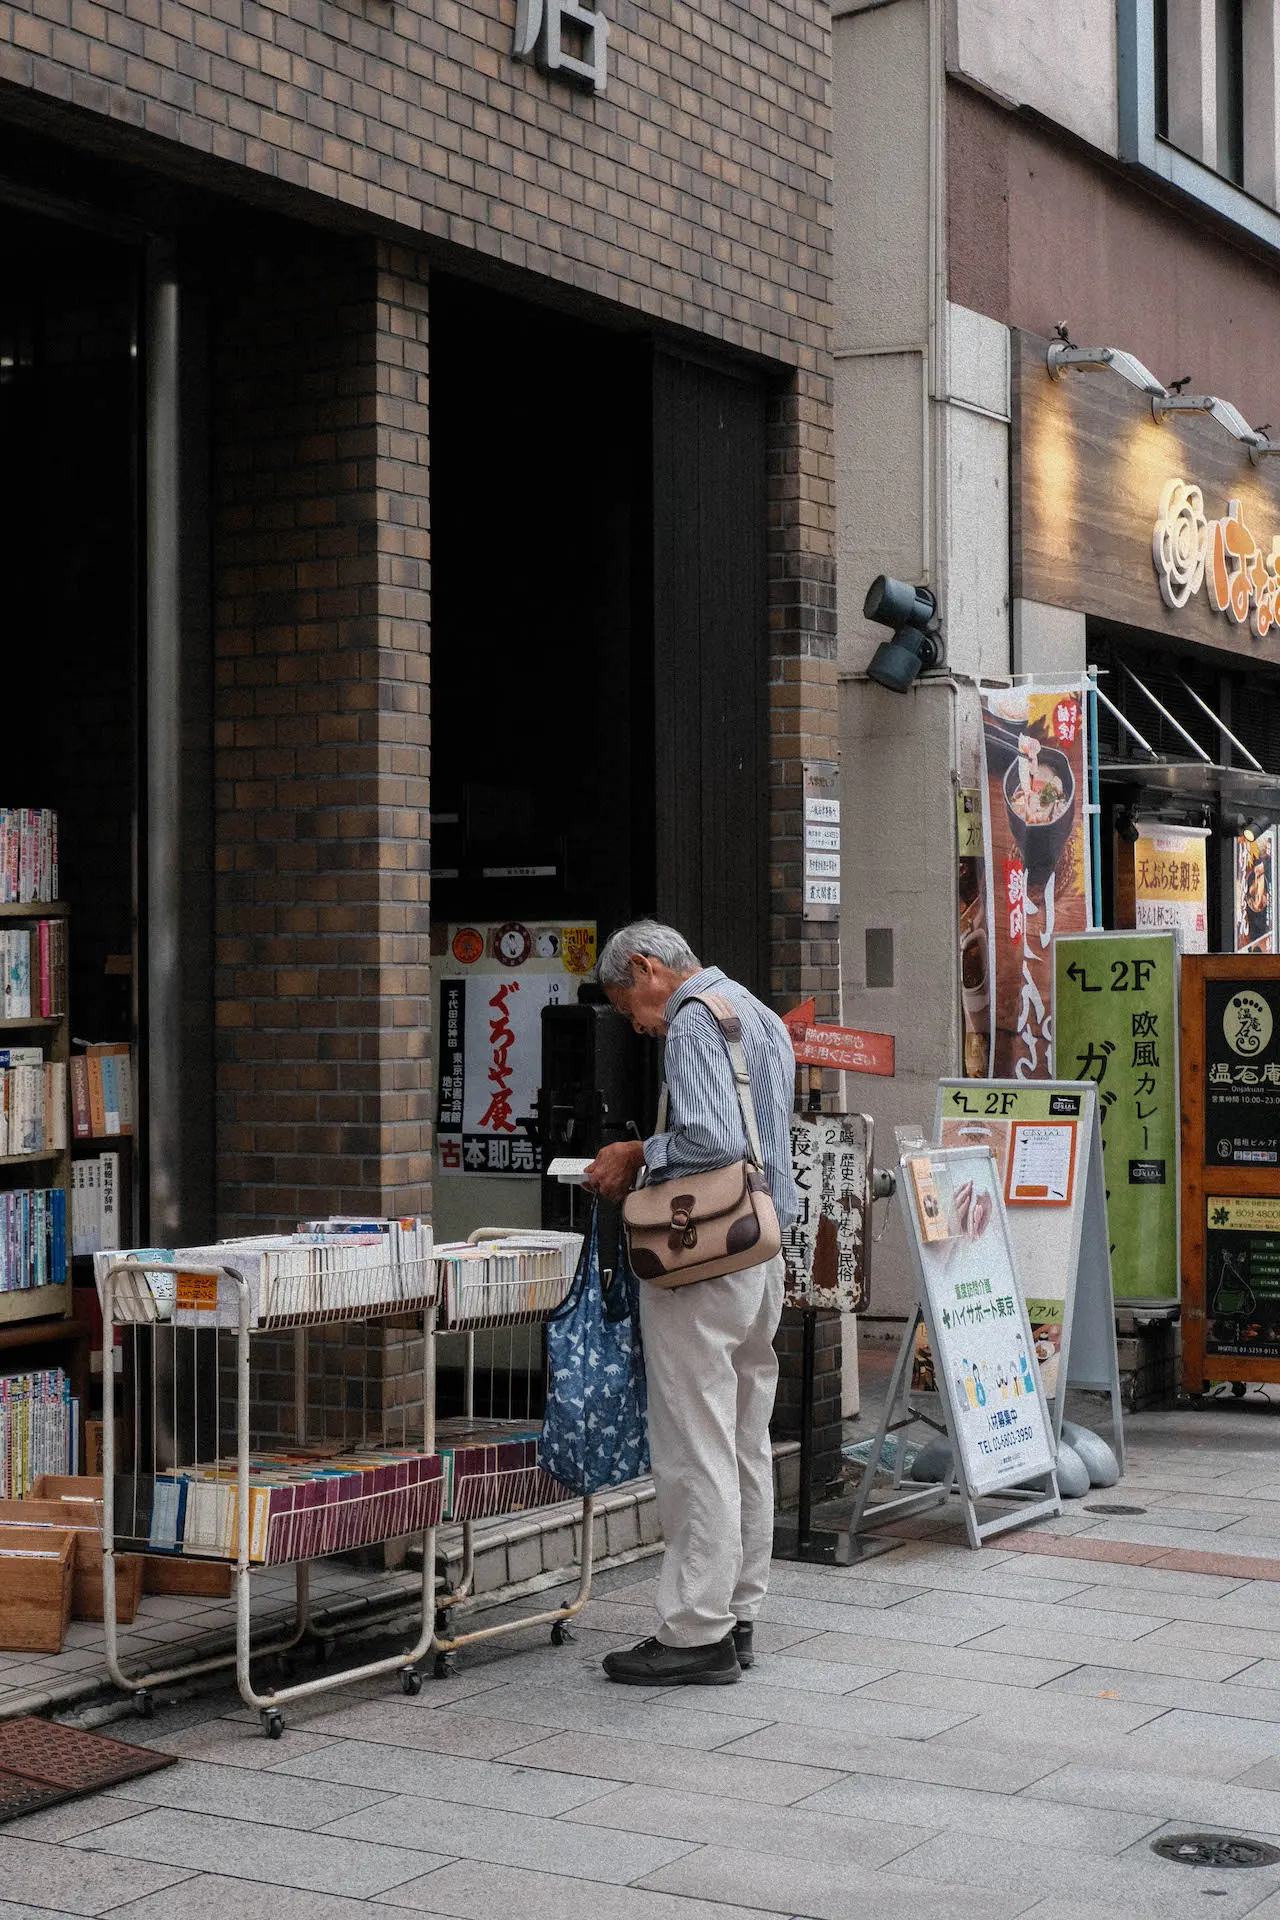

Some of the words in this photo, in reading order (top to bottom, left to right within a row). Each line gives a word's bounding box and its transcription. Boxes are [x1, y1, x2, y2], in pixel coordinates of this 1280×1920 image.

[1138, 860, 1200, 891] 天ぷら定期券
[1110, 960, 1156, 991] 2F
[447, 990, 459, 1048] 千代田区神田
[451, 1052, 463, 1123] 東京古書会館
[1131, 1010, 1160, 1150] 欧風カレー
[440, 1075, 452, 1123] 地下一階
[984, 1093, 1018, 1115] 2F
[440, 1138, 542, 1170] 古本即売
[103, 1162, 113, 1214] 情報科学辞典
[951, 1295, 1016, 1327] ハイサポート東京
[986, 1409, 1018, 1431] 人材募集中
[978, 1439, 993, 1454] TEL
